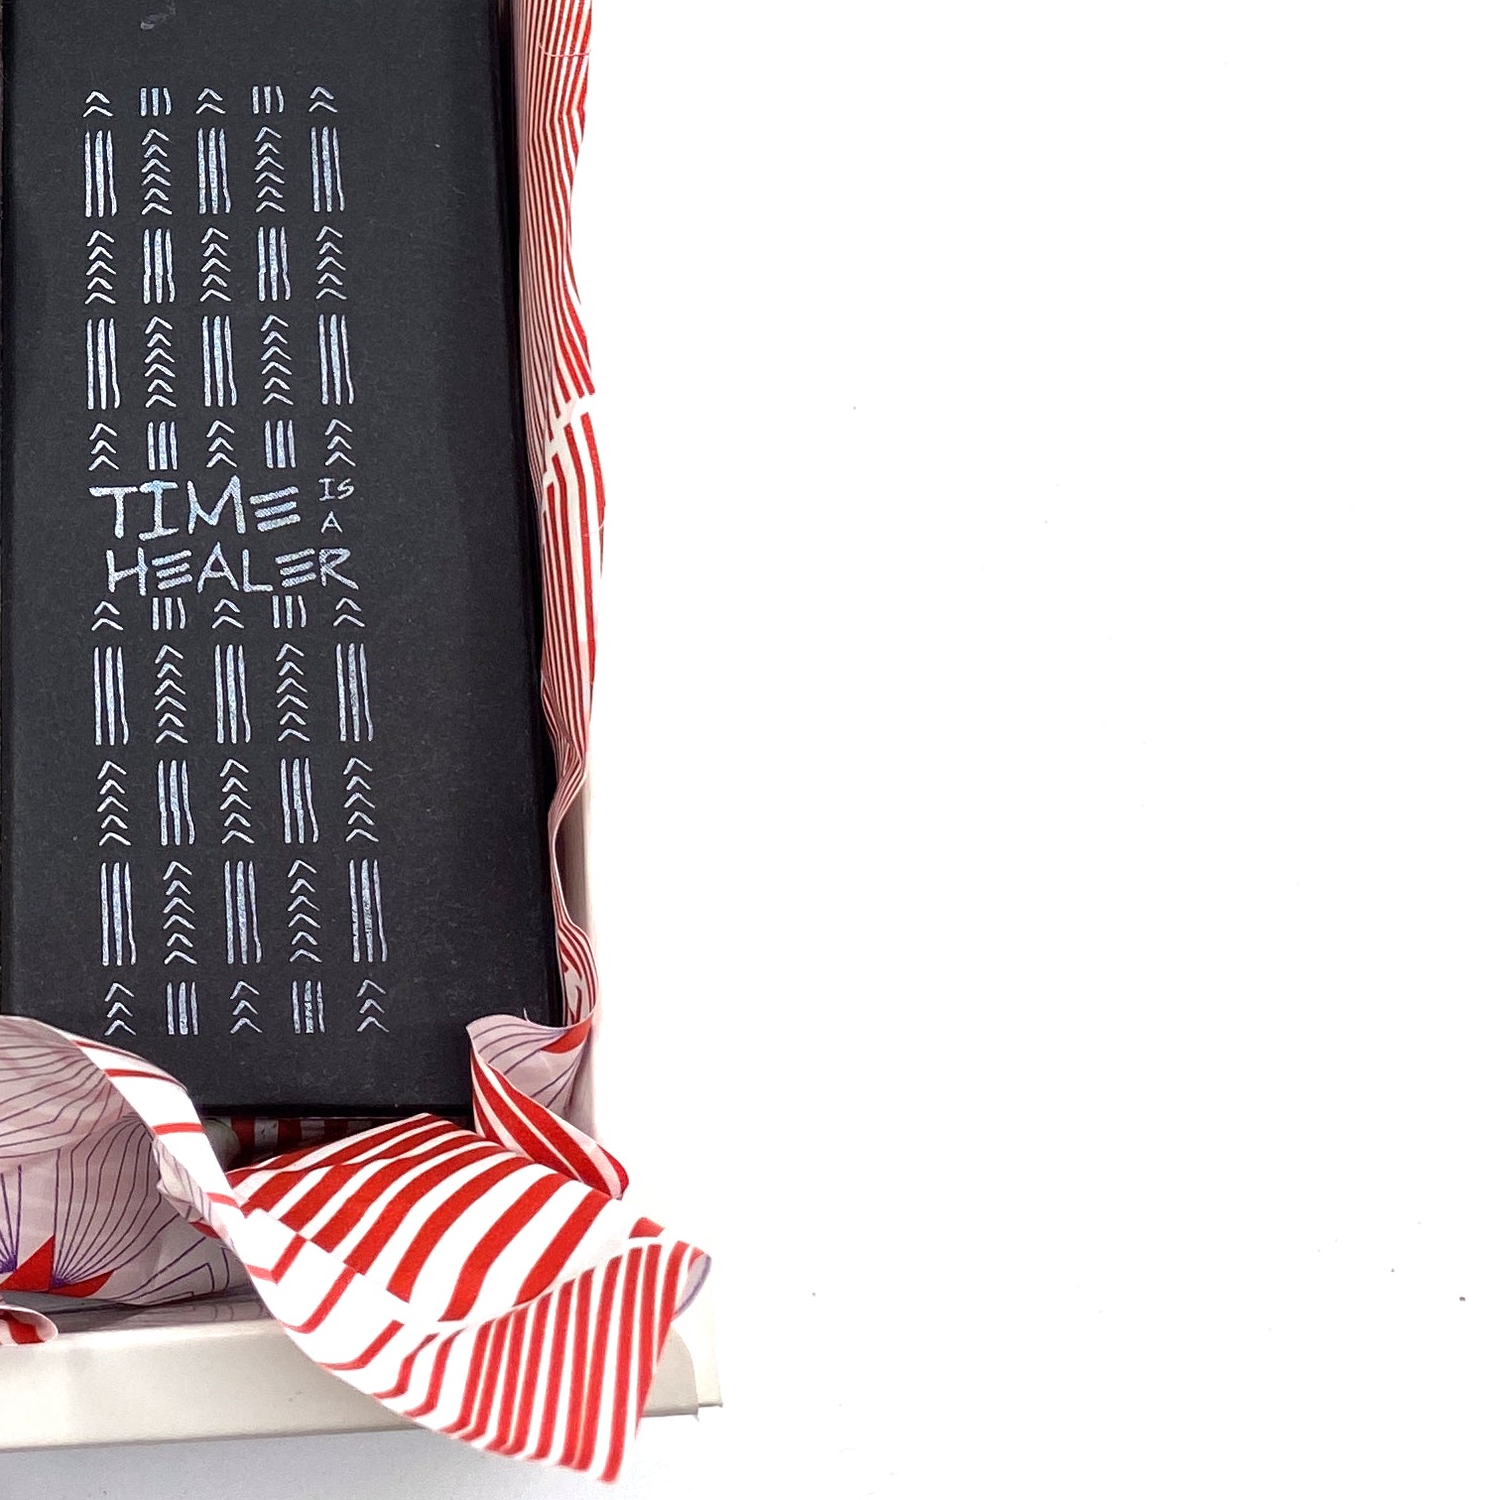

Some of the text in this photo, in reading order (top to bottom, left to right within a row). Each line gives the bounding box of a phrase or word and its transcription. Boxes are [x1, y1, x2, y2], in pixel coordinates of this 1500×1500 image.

[89, 475, 301, 541] TIME
[318, 478, 355, 501] IS
[321, 510, 343, 534] A
[106, 541, 359, 596] HEALER
